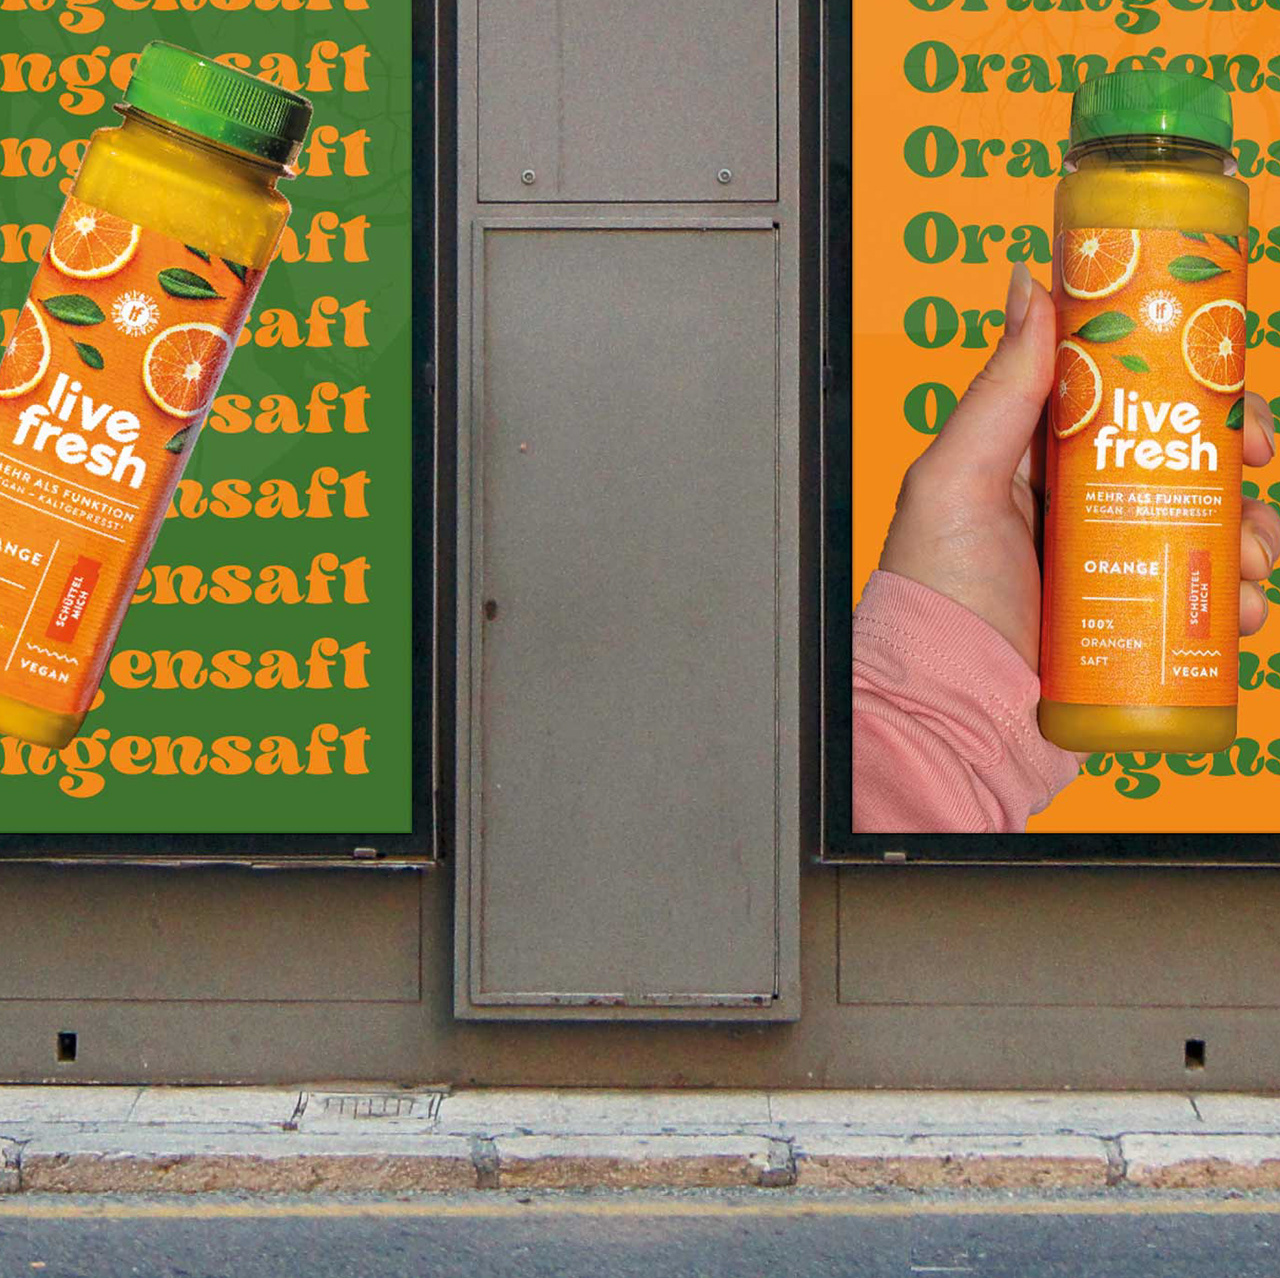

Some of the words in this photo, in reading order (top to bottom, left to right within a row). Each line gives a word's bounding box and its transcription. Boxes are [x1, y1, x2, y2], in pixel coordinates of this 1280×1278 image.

[47, 372, 141, 443] live
[1113, 388, 1201, 434] live
[12, 404, 147, 489] fresh
[1094, 425, 1218, 471] fresh
[33, 478, 59, 494] ALS
[62, 489, 134, 523] FUNKTION
[1085, 492, 1123, 502] MEHR
[1128, 492, 1151, 504] ALS
[1155, 493, 1222, 505] FUNKTION
[1085, 505, 1123, 515] VEGAN
[1084, 560, 1159, 576] ORANGE
[70, 591, 89, 620] MICH
[1200, 583, 1209, 612] MICH
[1081, 619, 1114, 630] 100%
[20, 658, 69, 684] VEGAN
[1080, 656, 1108, 666] SAFT
[1172, 667, 1218, 677] VEGAN
